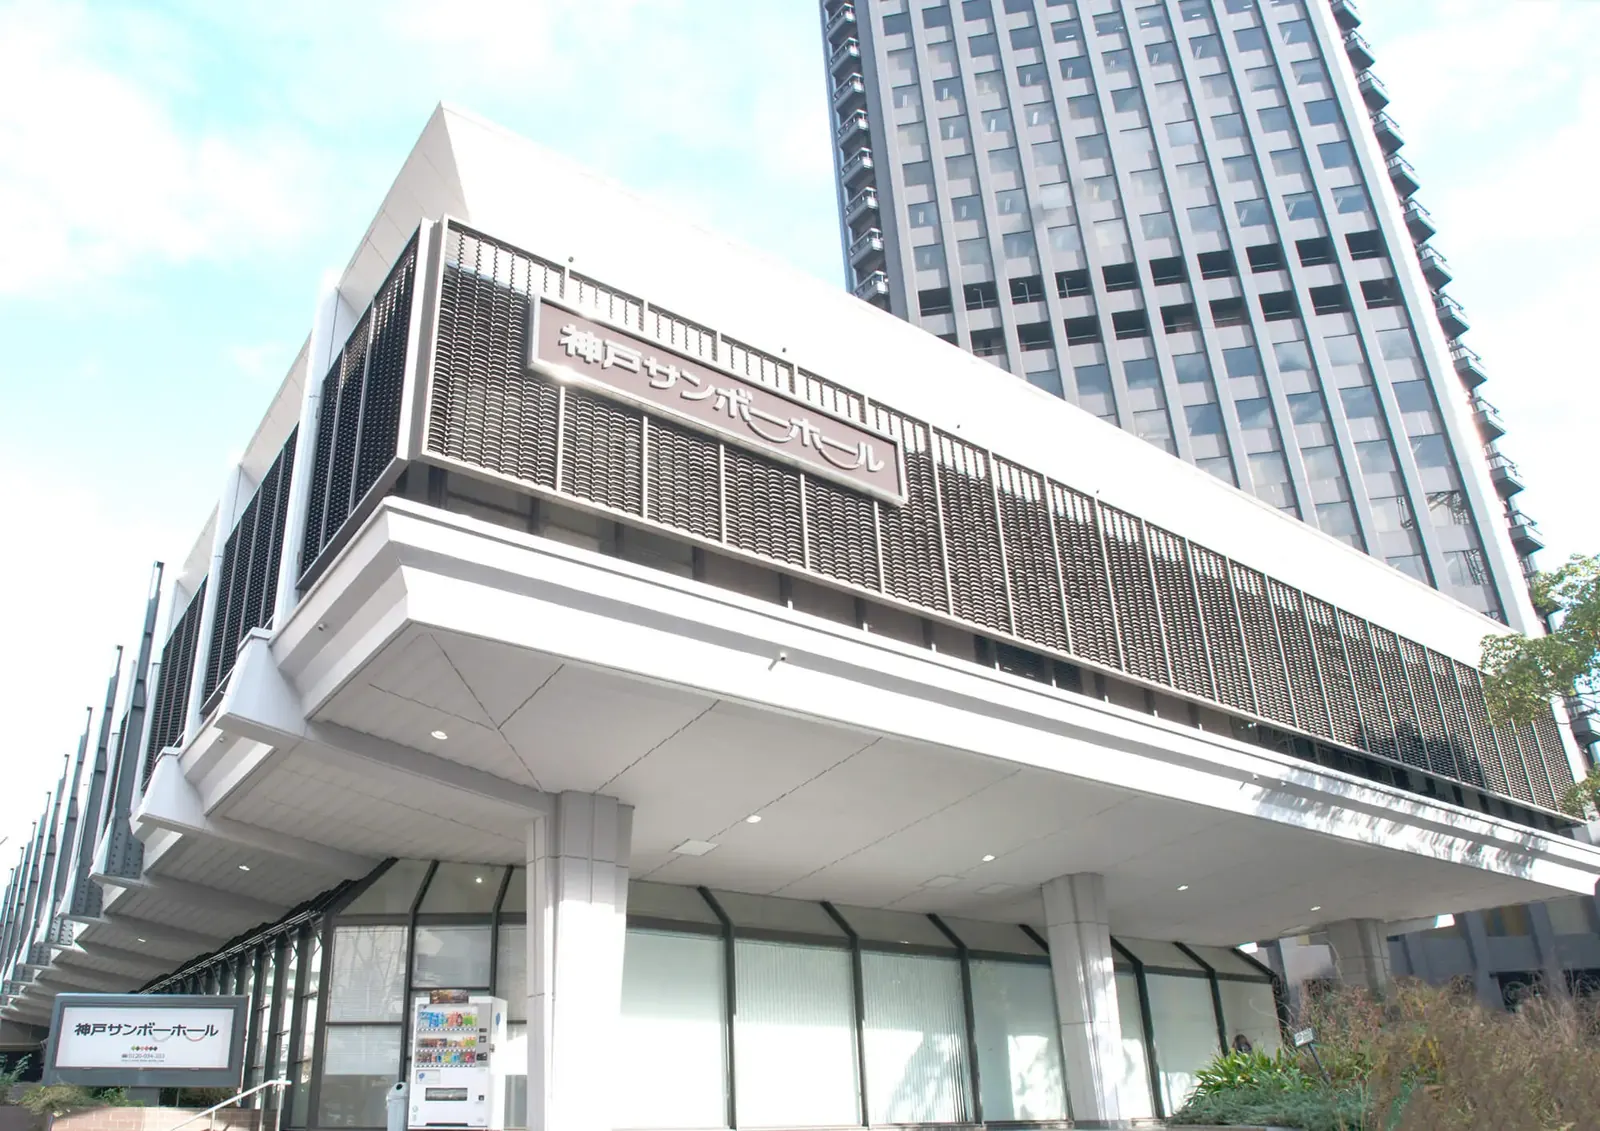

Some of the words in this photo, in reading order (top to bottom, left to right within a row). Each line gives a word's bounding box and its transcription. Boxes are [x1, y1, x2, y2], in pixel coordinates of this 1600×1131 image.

[558, 323, 884, 472] 神戸サンボーホール
[74, 1022, 219, 1039] 神戸サンボーホール
